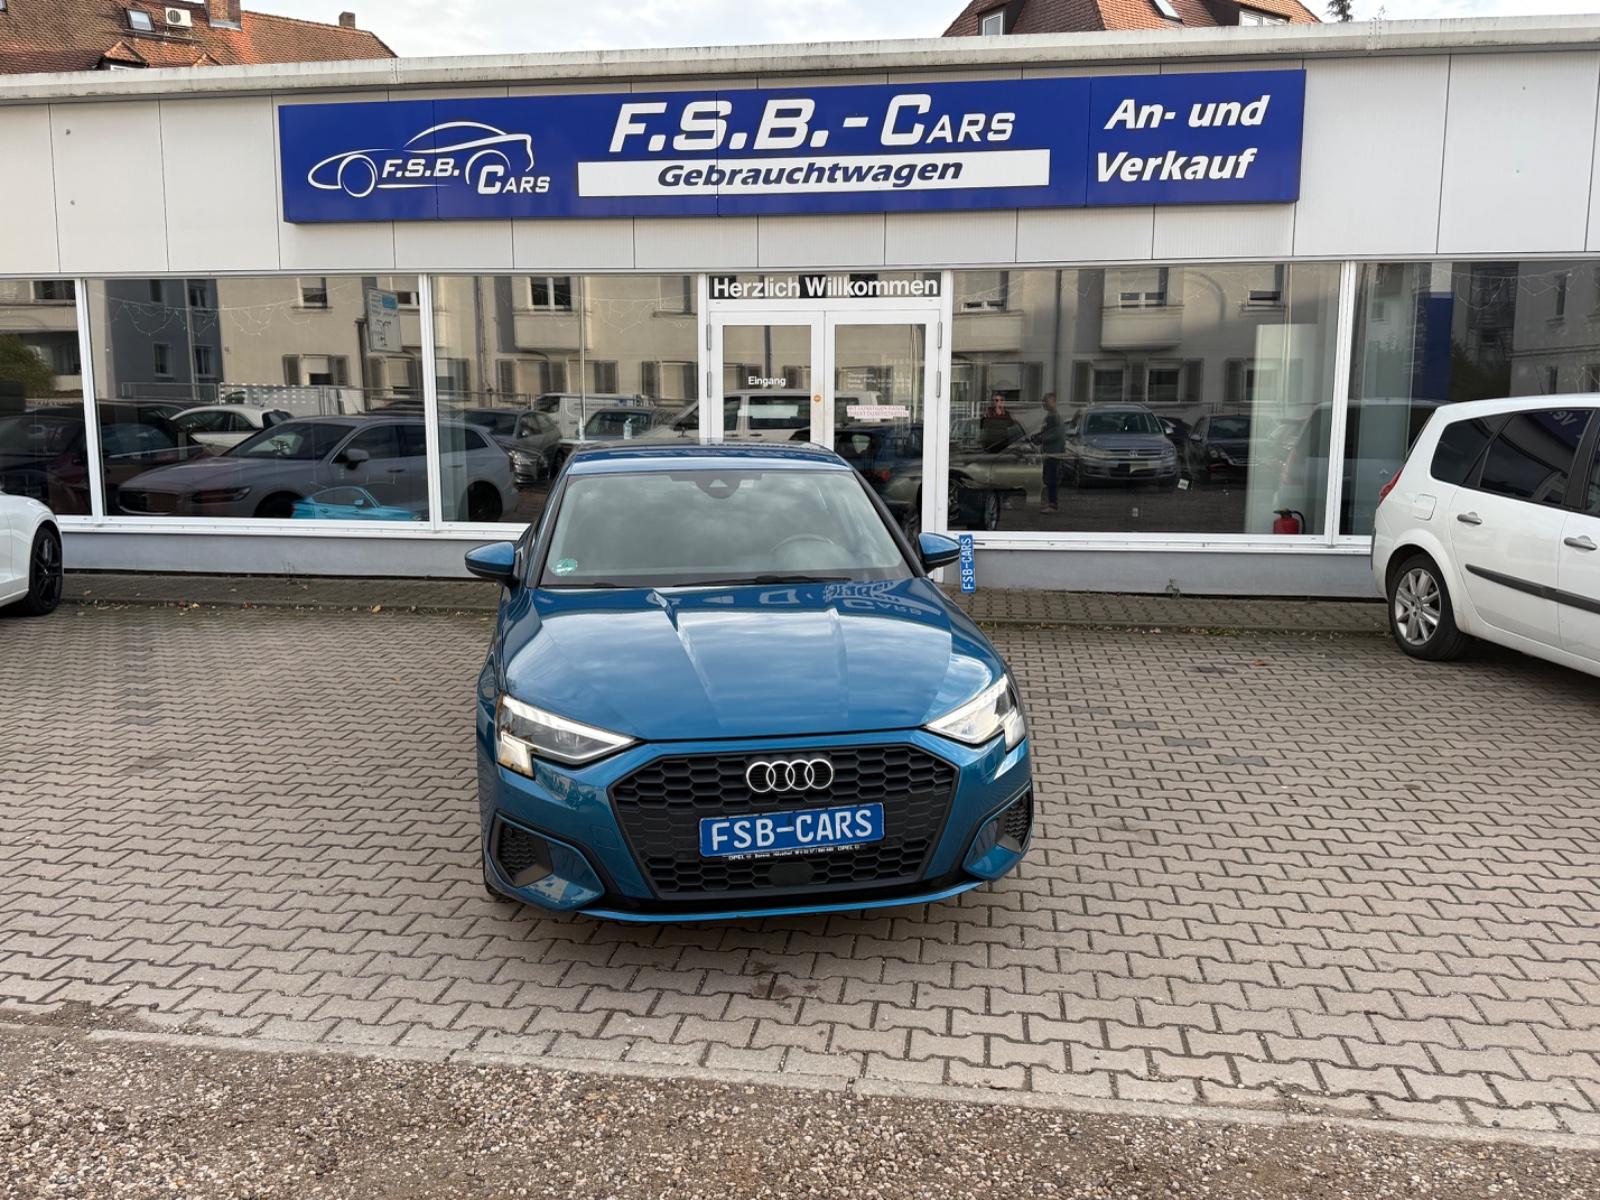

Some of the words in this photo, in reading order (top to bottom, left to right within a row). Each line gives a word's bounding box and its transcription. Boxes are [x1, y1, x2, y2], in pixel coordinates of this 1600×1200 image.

[609, 98, 829, 152] F.S.B.
[1104, 99, 1177, 130] An-
[1188, 94, 1270, 128] und
[381, 157, 460, 178] F.S.B.
[658, 161, 963, 188] Gebrauchtwagen
[1097, 148, 1257, 182] Verkauf
[713, 276, 801, 298] Herzlich
[804, 277, 939, 298] Willkommen
[748, 375, 787, 387] Eingang
[960, 537, 974, 590] FSB-CARS
[712, 809, 872, 852] FSB-CARS
